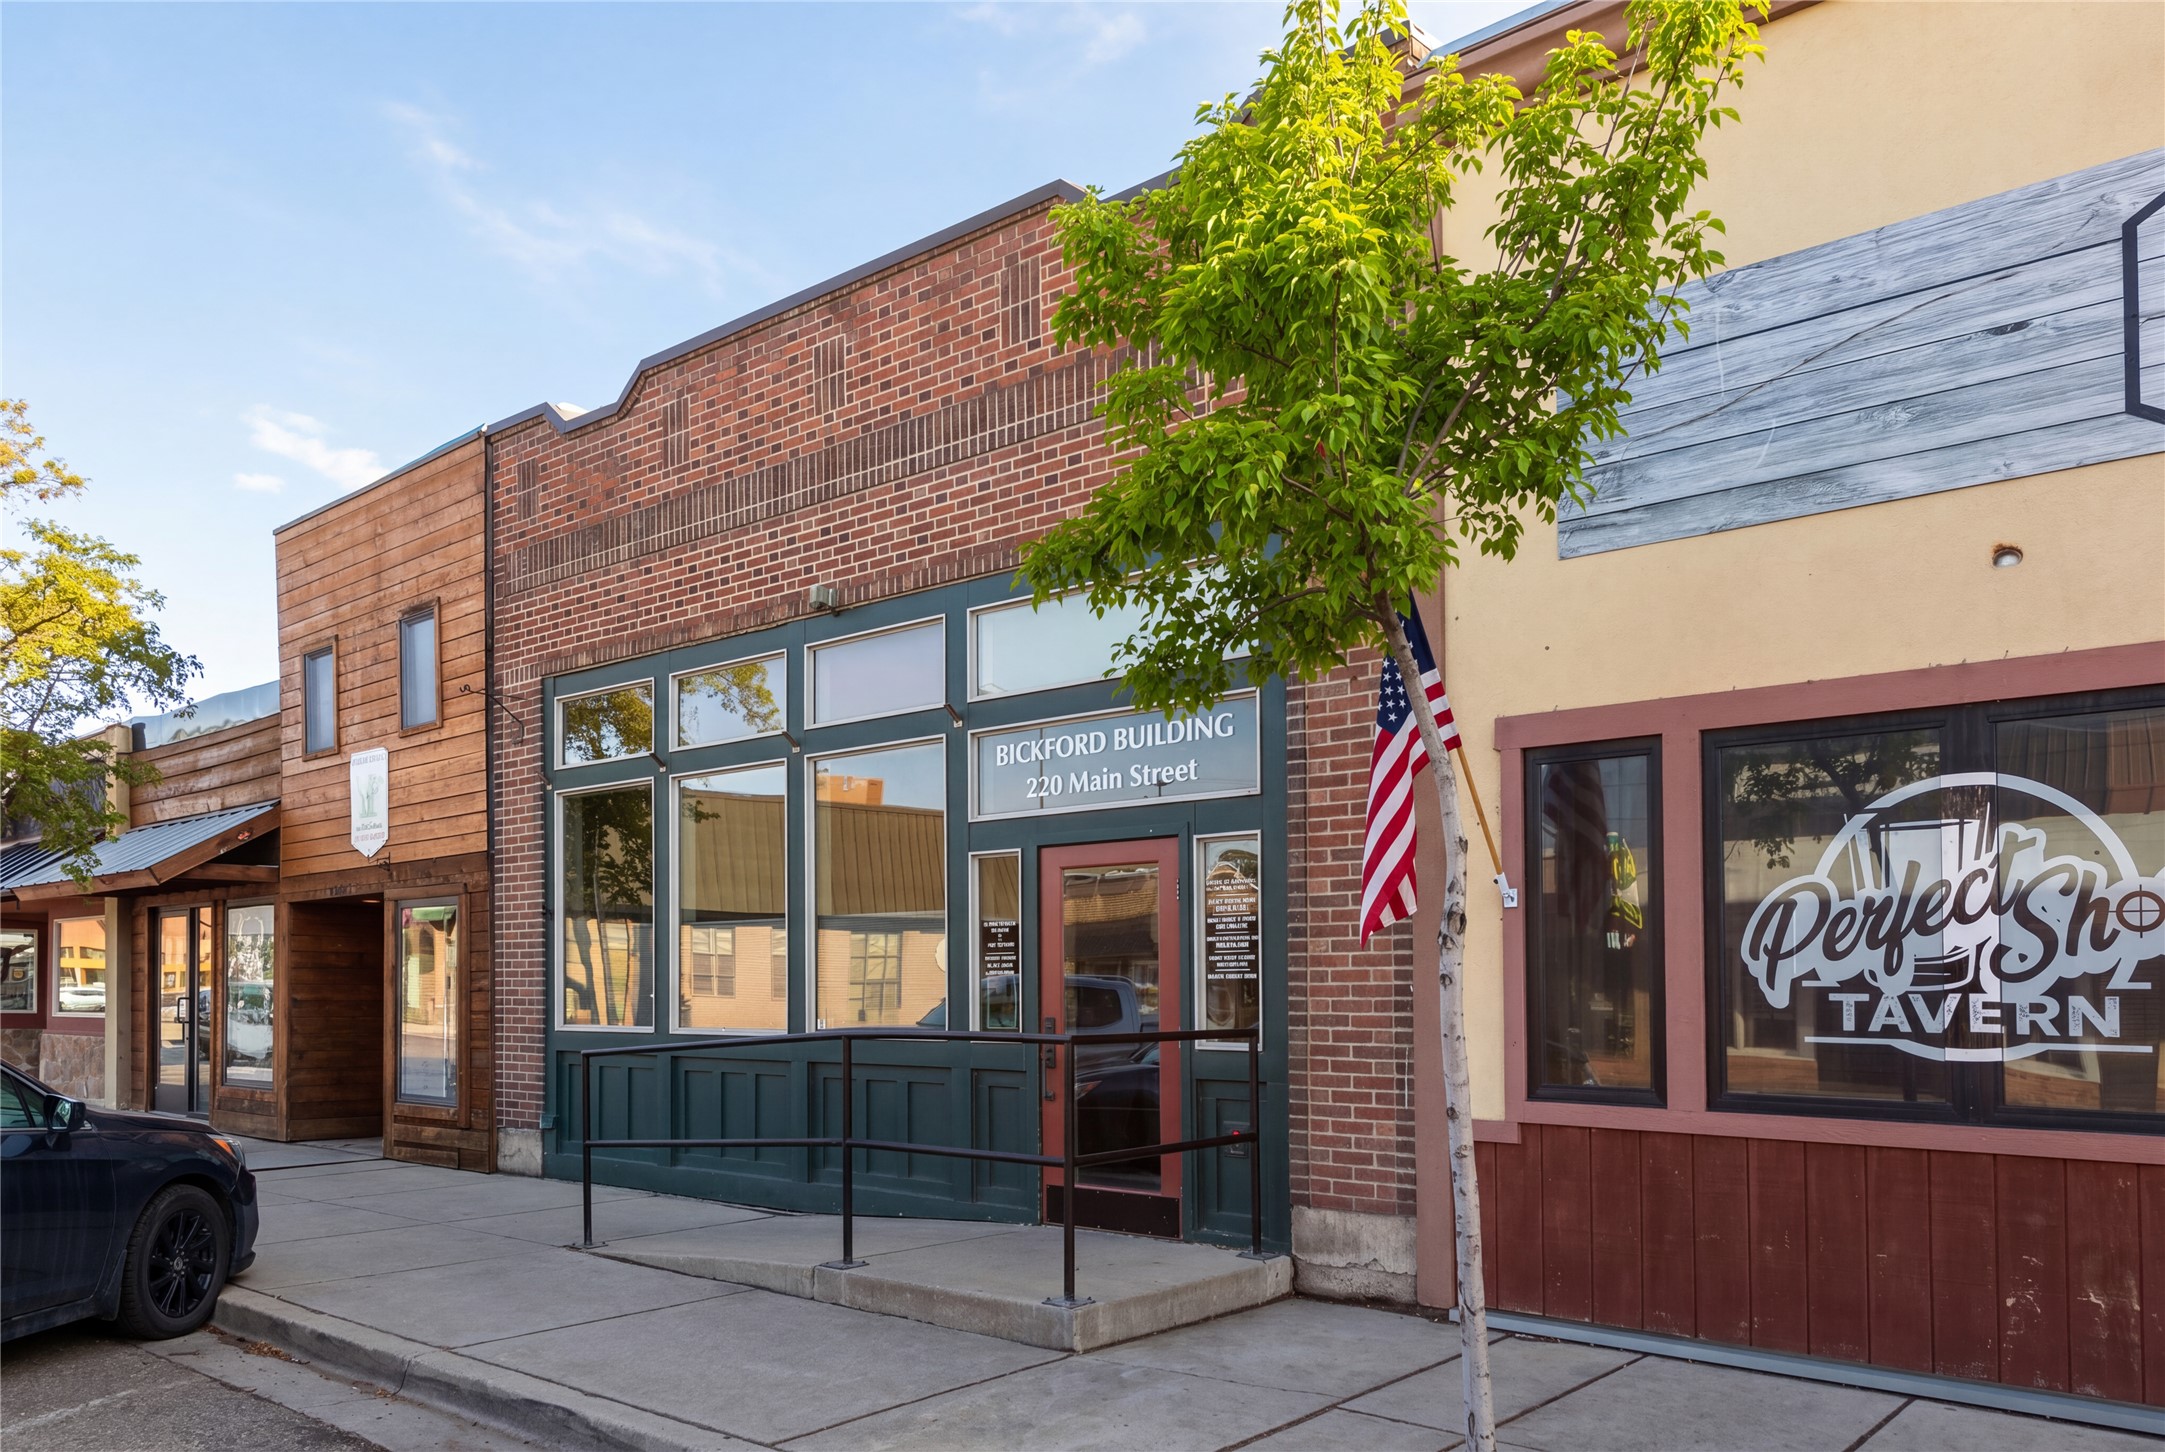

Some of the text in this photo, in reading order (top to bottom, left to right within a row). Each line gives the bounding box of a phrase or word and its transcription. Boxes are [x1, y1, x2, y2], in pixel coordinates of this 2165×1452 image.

[996, 712, 1235, 767] BICKFORD BUILDING
[1026, 758, 1199, 799] 220 Main Street
[1748, 829, 2165, 991] Perfect Sho
[1828, 993, 2121, 1038] TAVERN
